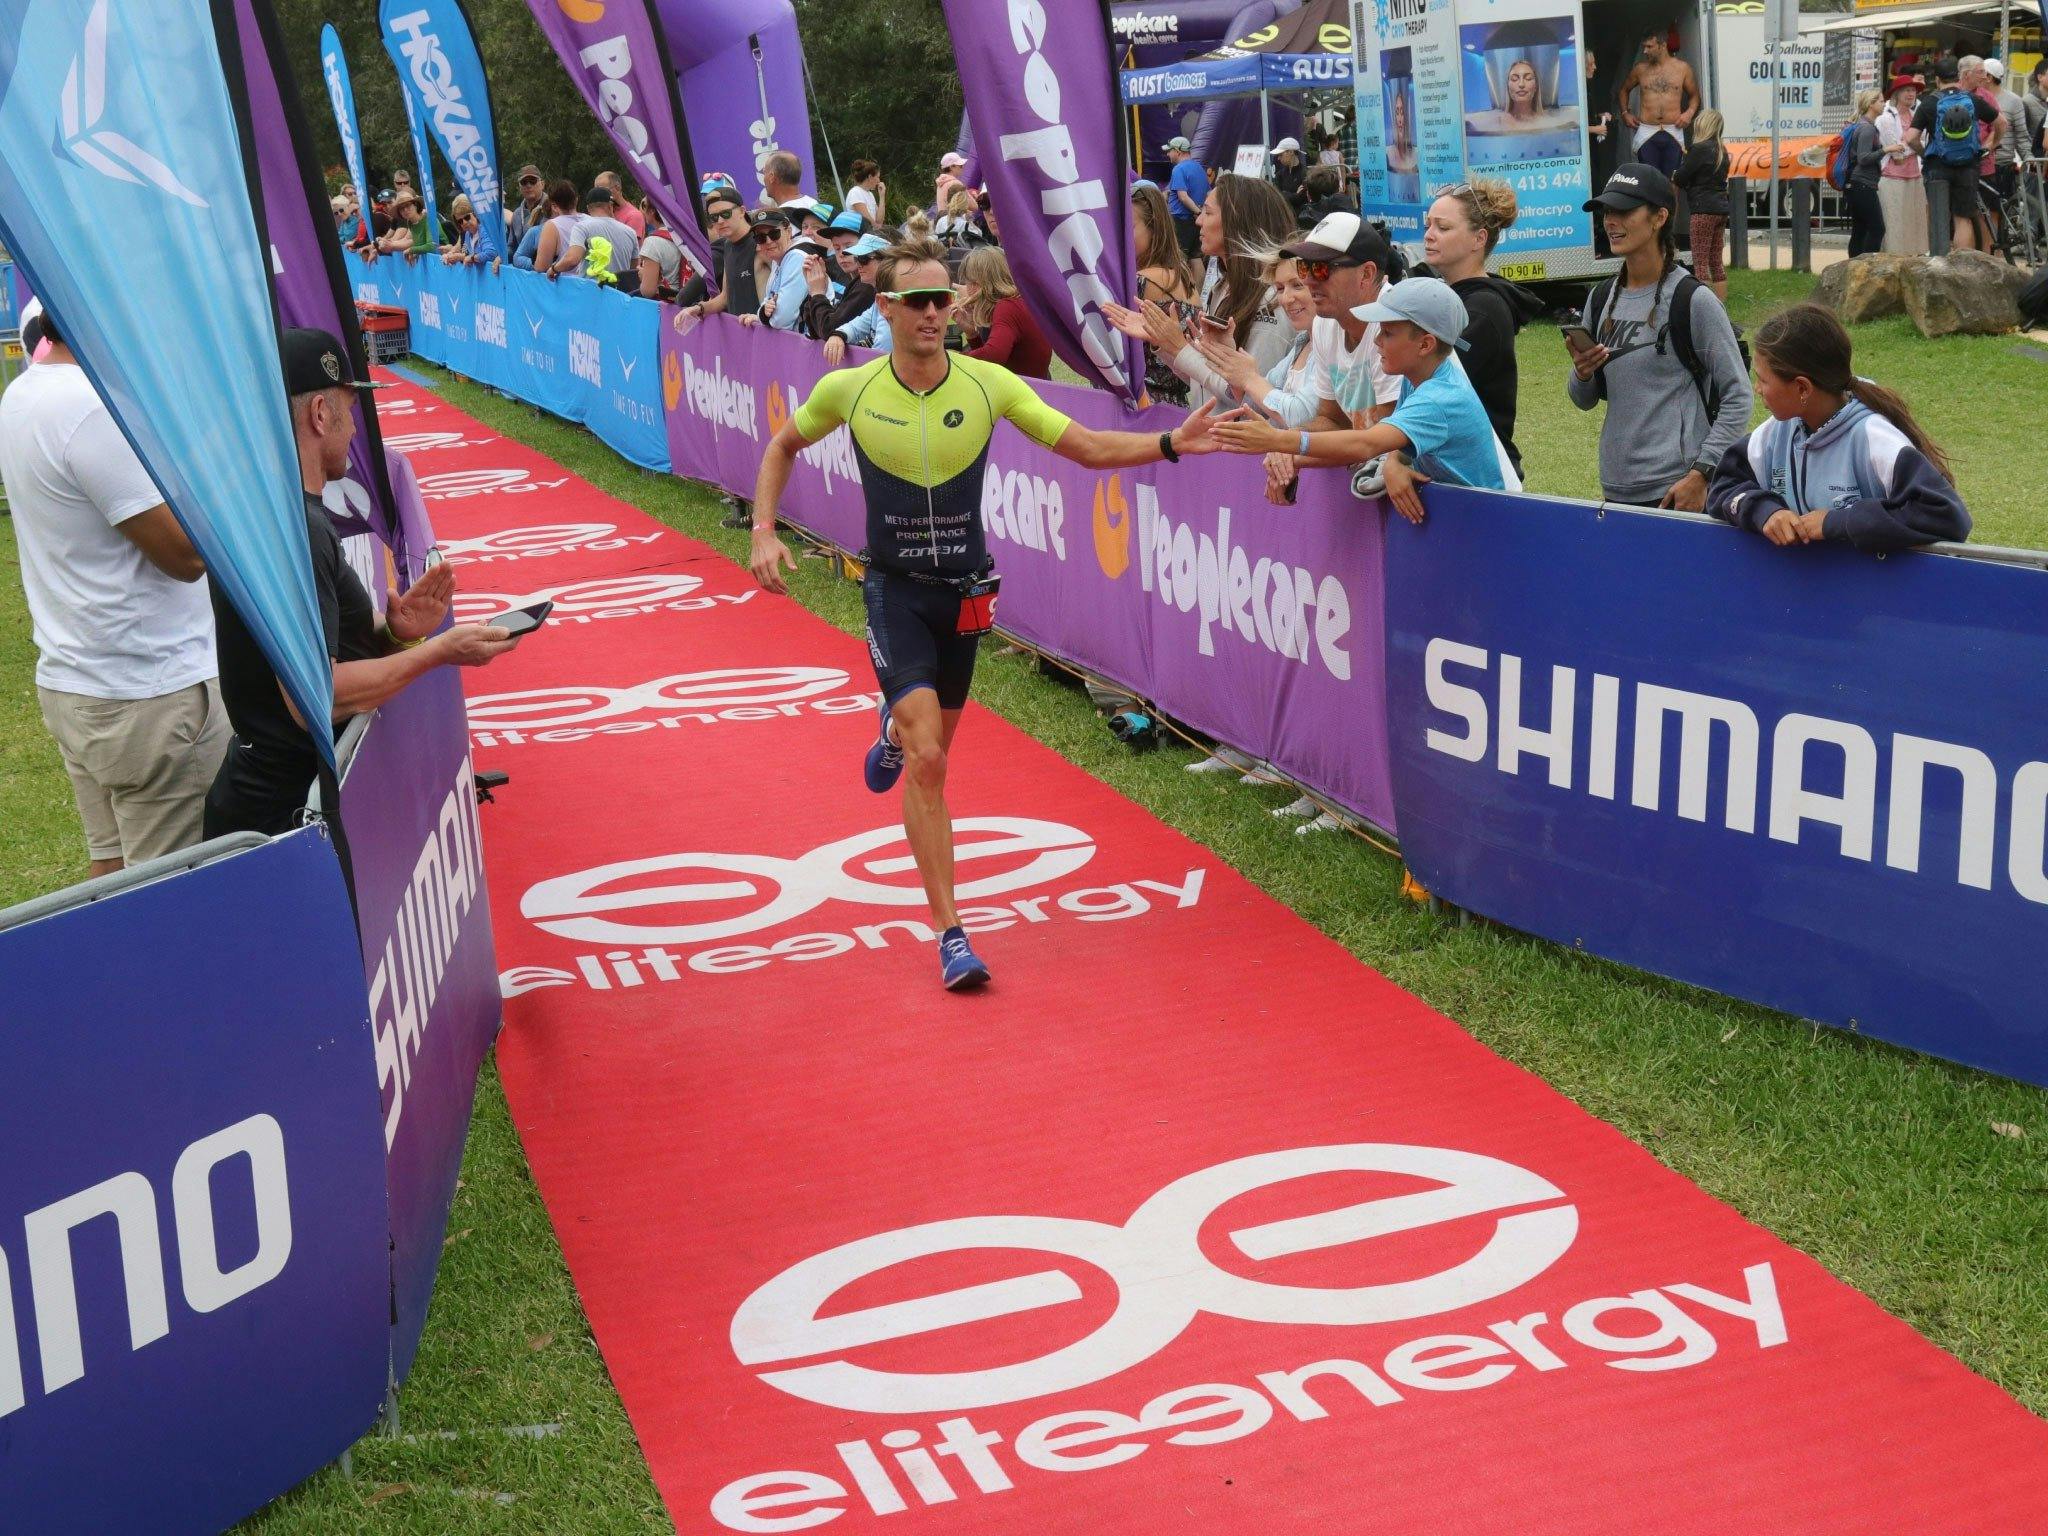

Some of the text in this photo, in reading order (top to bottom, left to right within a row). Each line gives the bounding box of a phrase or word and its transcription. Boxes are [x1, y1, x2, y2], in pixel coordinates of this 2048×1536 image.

[1133, 33, 1158, 44] health
[389, 9, 480, 161] HOKA
[1766, 119, 1792, 130] 002
[1518, 175, 1546, 191] 413
[1552, 170, 1583, 187] 494
[1509, 225, 1573, 240] @nitrocryo
[613, 390, 655, 427] TIME TO FLY
[885, 514, 908, 526] METS
[1136, 482, 1352, 681] Peoplecare
